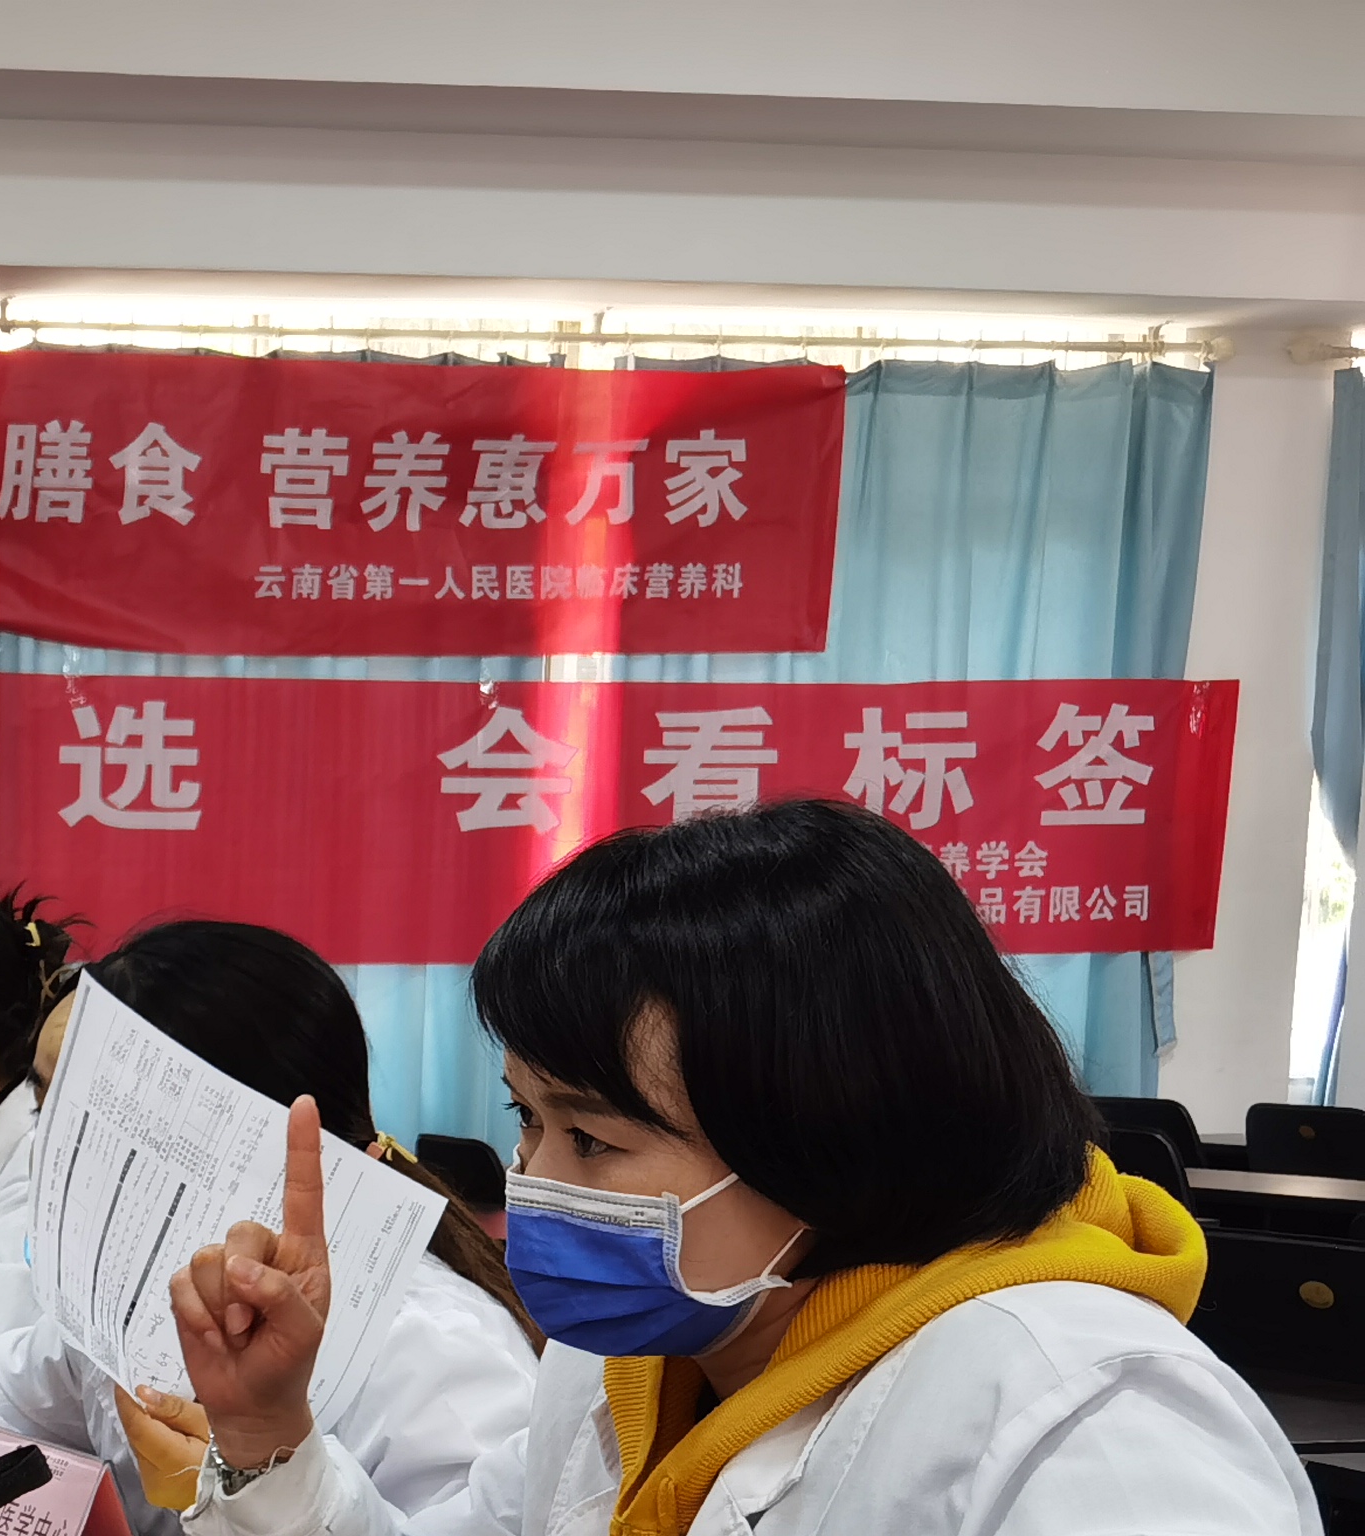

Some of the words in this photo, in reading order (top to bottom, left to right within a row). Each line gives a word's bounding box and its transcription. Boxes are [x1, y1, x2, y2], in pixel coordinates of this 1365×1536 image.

[260, 426, 751, 534] 营养惠万家
[252, 561, 745, 602] 云南省第一人民医院临床营养科
[923, 840, 1049, 881] 养学会
